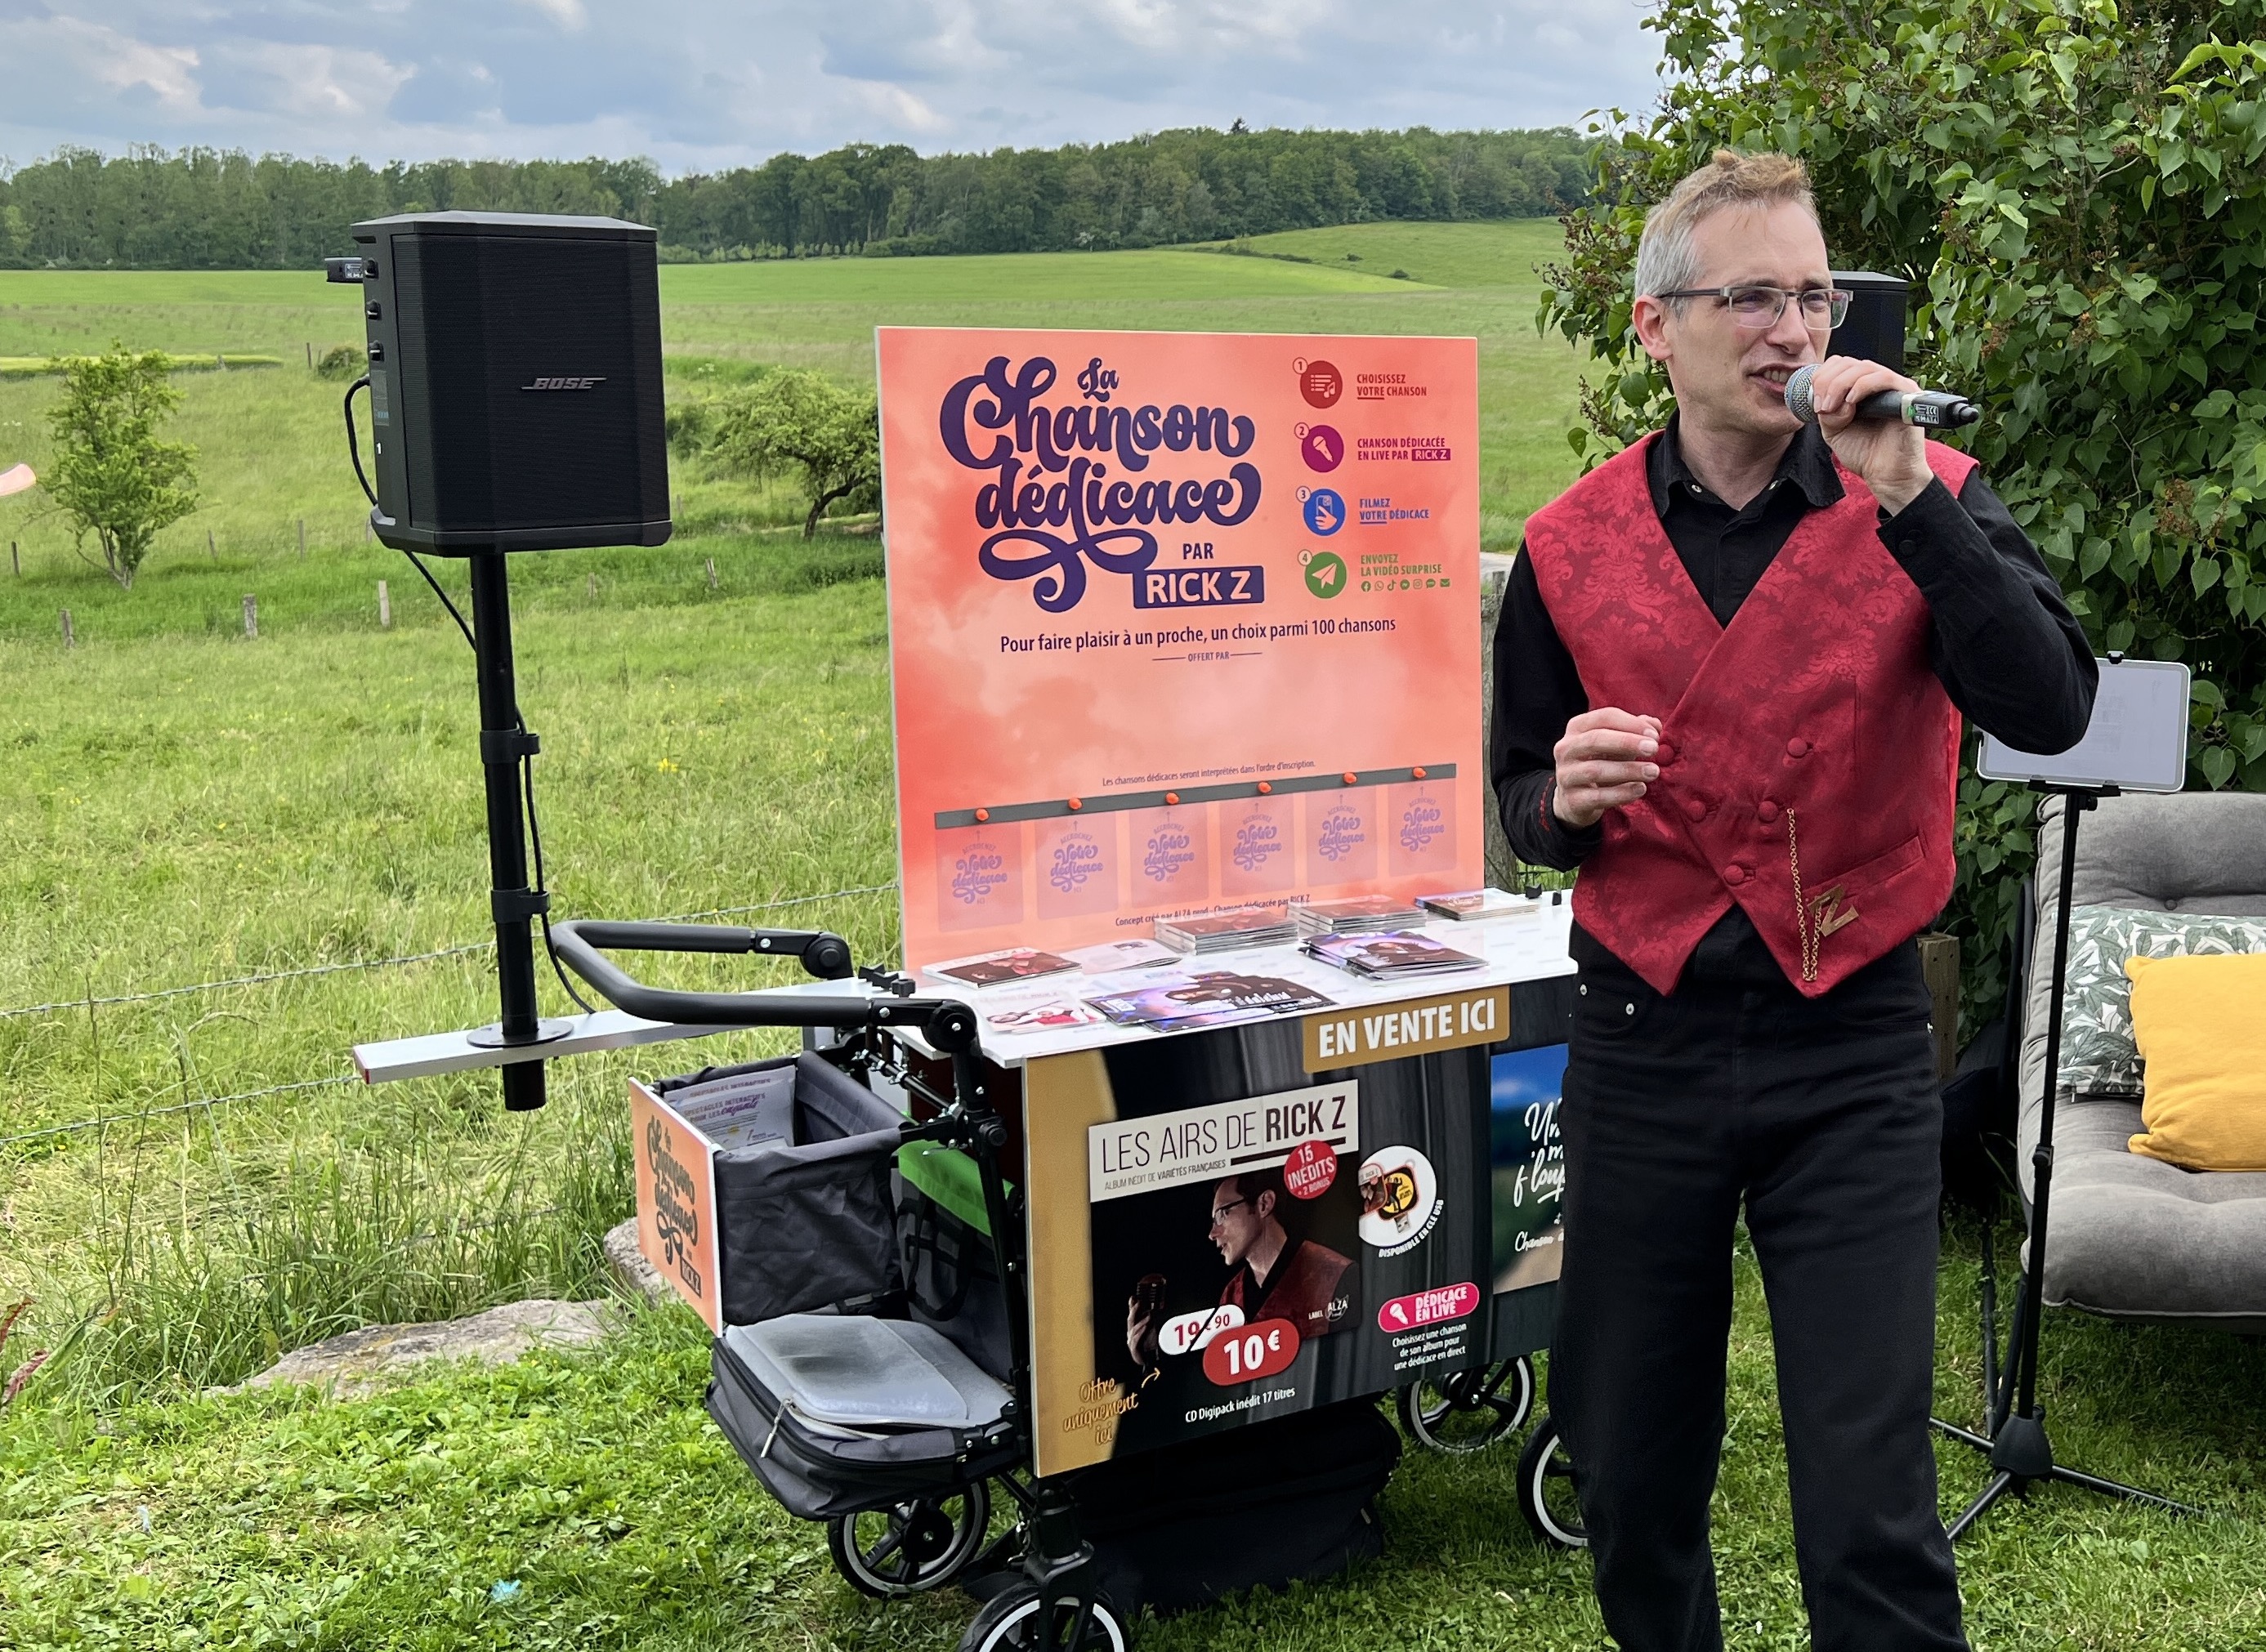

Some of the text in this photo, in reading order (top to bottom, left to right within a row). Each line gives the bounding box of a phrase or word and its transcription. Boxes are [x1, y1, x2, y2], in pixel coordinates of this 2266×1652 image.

[1298, 361, 1303, 371] 1
[521, 377, 606, 389] BOSE
[1078, 358, 1118, 402] La
[1356, 373, 1406, 384] CHOISISSEZ
[1356, 386, 1427, 396] VOTRE CHANSON
[940, 355, 1255, 472] Chanson
[1299, 426, 1305, 436] 2
[376, 442, 382, 455] 1
[1357, 436, 1446, 449] CHANSON DÉDICACÉE
[1357, 449, 1447, 461] EN LIVE PAR RICK Z
[1301, 490, 1306, 500] 3
[1359, 498, 1390, 508] FILMEZ
[976, 456, 1262, 583] dédicace
[1360, 509, 1429, 520] VOTRE DÉDICACE
[1182, 542, 1213, 560] PAR
[1302, 553, 1307, 562] 4
[1361, 554, 1398, 564] ENVOYEZ
[1361, 564, 1442, 577] LA VIDÉO SURPRISE
[1146, 569, 1252, 604] RICK Z
[1000, 617, 1396, 653] Pour faire plaisir à un proche, un choix parmi 100 chansons
[1187, 651, 1229, 662] OFFERT PAR
[1102, 778, 1114, 787] Les
[1115, 775, 1146, 785] chansons
[1146, 772, 1178, 782] dédicaces
[1179, 770, 1200, 779] seront
[1240, 765, 1255, 774] dans
[1256, 763, 1275, 772] l'ordre
[1115, 916, 1143, 926] Concept
[1320, 998, 1495, 1058] EN VENTE ICI
[1103, 1096, 1347, 1173] LES AIRS DE RICK Z
[1105, 1159, 1226, 1190] ALBUM INÉDIT DE VARIÉTÉS FRANÇAISES
[1288, 1156, 1335, 1190] INÉDITS
[1328, 1299, 1348, 1311] ALZA
[1415, 1287, 1467, 1310] DÉDICACE
[1415, 1302, 1456, 1322] EN LIVE
[1392, 1324, 1467, 1347] Choisissez une chanson
[1223, 1329, 1280, 1375] 10€
[1400, 1337, 1459, 1357] de son album pour
[1394, 1346, 1466, 1371] une dédicace en direct
[1079, 1377, 1116, 1403] Offre
[1063, 1392, 1139, 1432] uniquement
[1185, 1387, 1295, 1422] CD Digipack inédit 17 titres
[1096, 1422, 1113, 1445] ici
